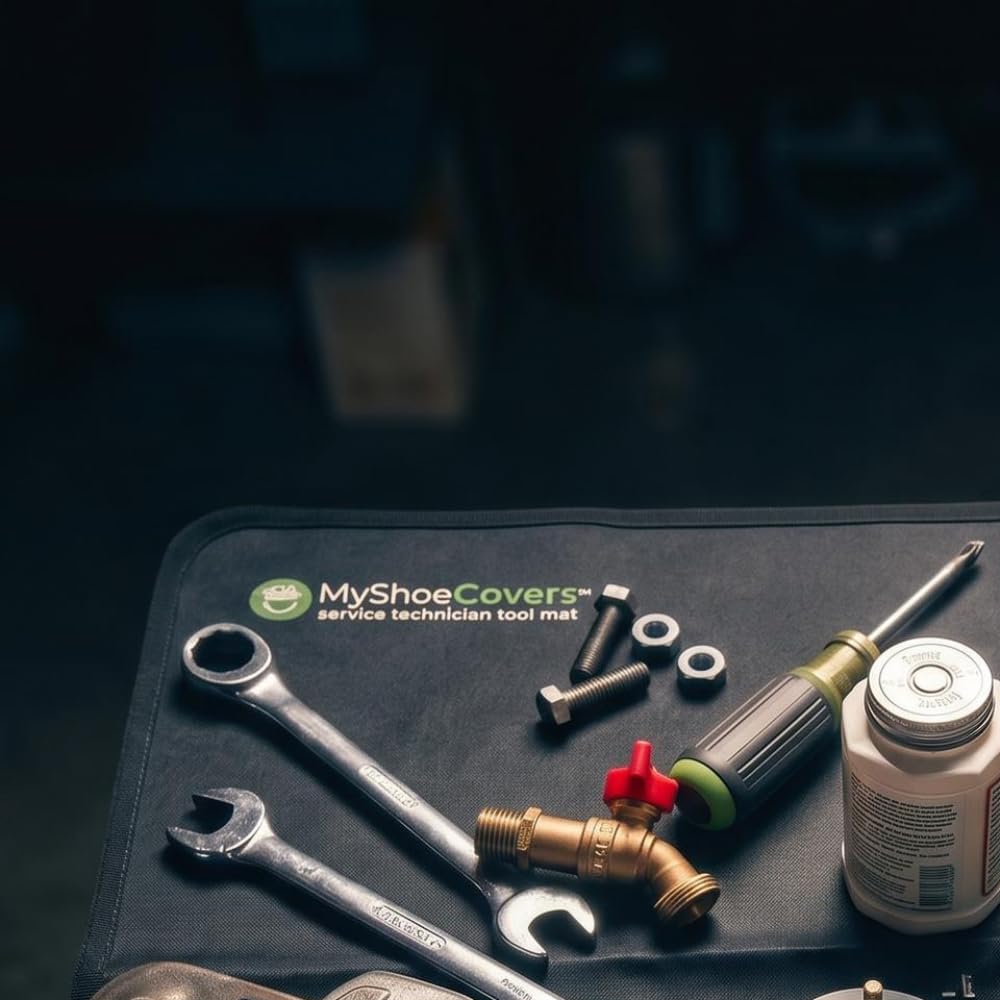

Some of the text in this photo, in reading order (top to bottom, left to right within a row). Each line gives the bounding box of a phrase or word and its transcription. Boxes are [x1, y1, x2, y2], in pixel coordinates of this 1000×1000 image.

[317, 606, 578, 620] service technician tool mat
